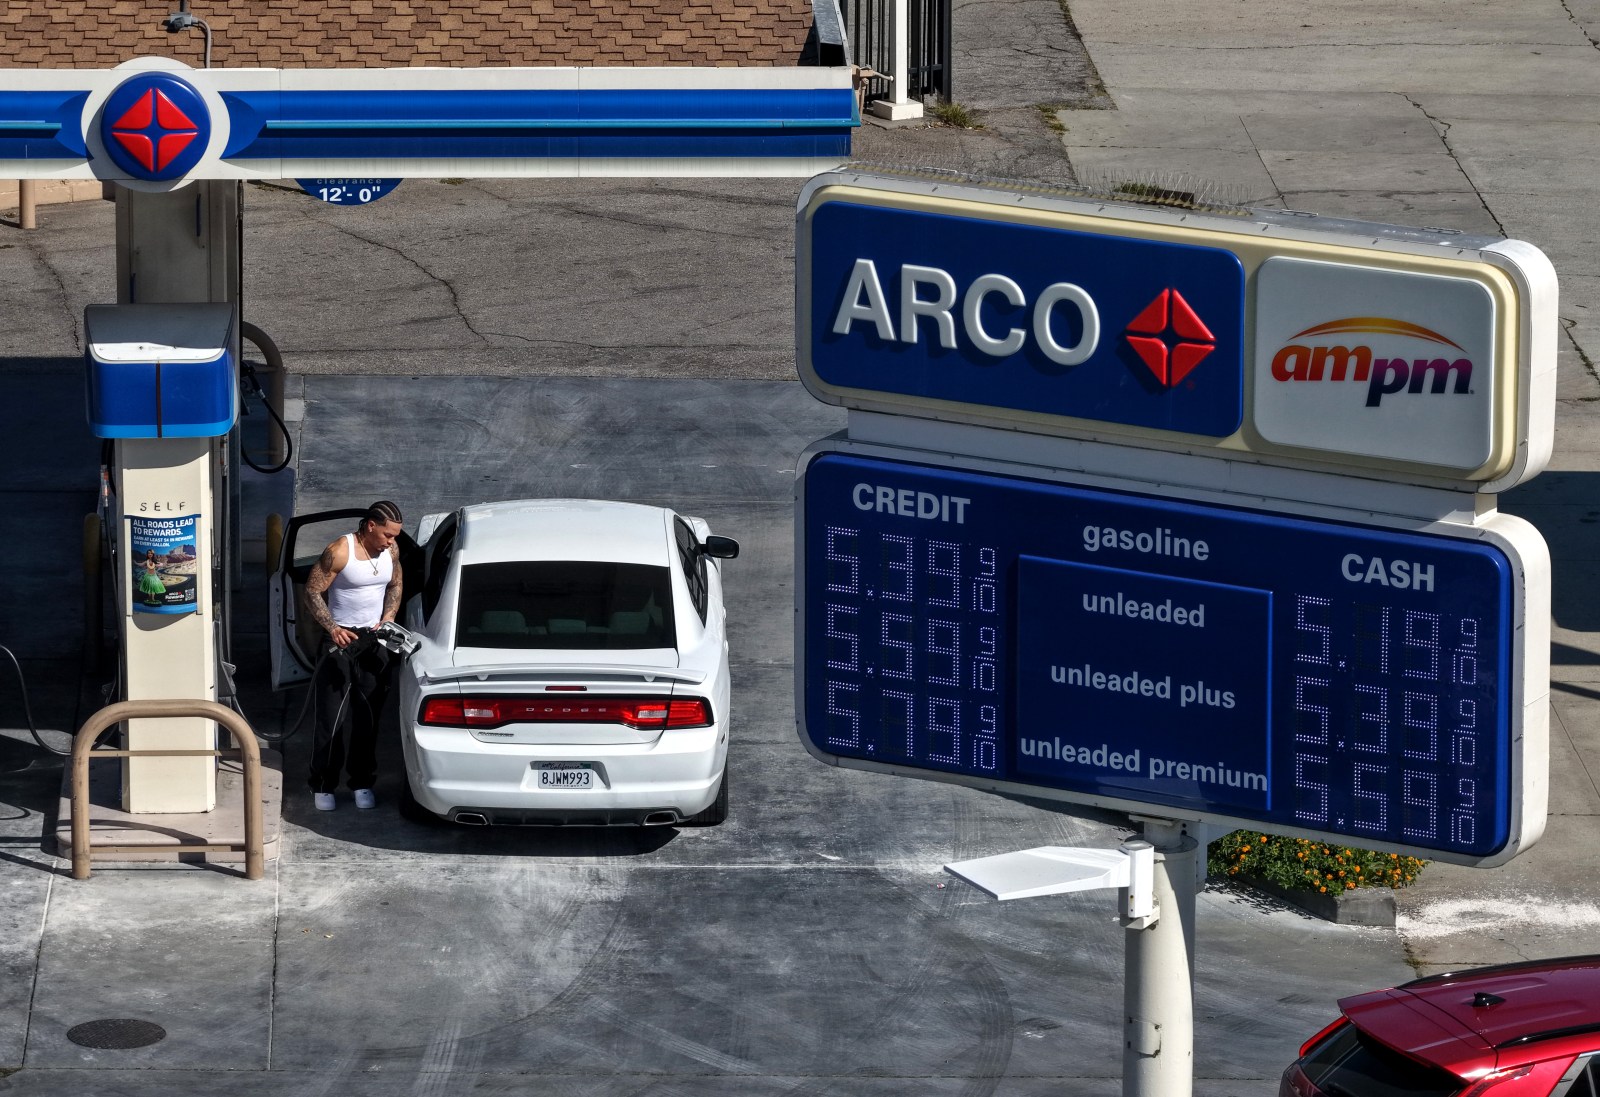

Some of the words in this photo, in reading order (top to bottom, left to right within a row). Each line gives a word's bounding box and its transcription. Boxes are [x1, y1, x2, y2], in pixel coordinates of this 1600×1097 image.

[316, 177, 383, 185] clearance
[832, 258, 1101, 366] ARCO
[1271, 344, 1474, 407] ampm
[133, 519, 146, 527] ALL
[176, 518, 193, 527] LEAD
[852, 483, 971, 524] CREDIT
[144, 528, 183, 536] REWARDS.
[1083, 524, 1210, 561] gasoline
[826, 525, 961, 609] 5.39
[1341, 553, 1435, 592] CASH
[1082, 592, 1205, 628] unleaded
[826, 602, 961, 688] 5.59
[1297, 594, 1439, 681] 5.19
[1051, 664, 1171, 699] unleaded
[1180, 681, 1236, 709] plus
[827, 680, 961, 766] 5.79
[1296, 675, 1438, 761] 5.39
[541, 771, 590, 785] 8JWM993
[1020, 737, 1141, 772] unleaded
[1149, 756, 1268, 791] premium
[1295, 752, 1437, 839] 5.59
